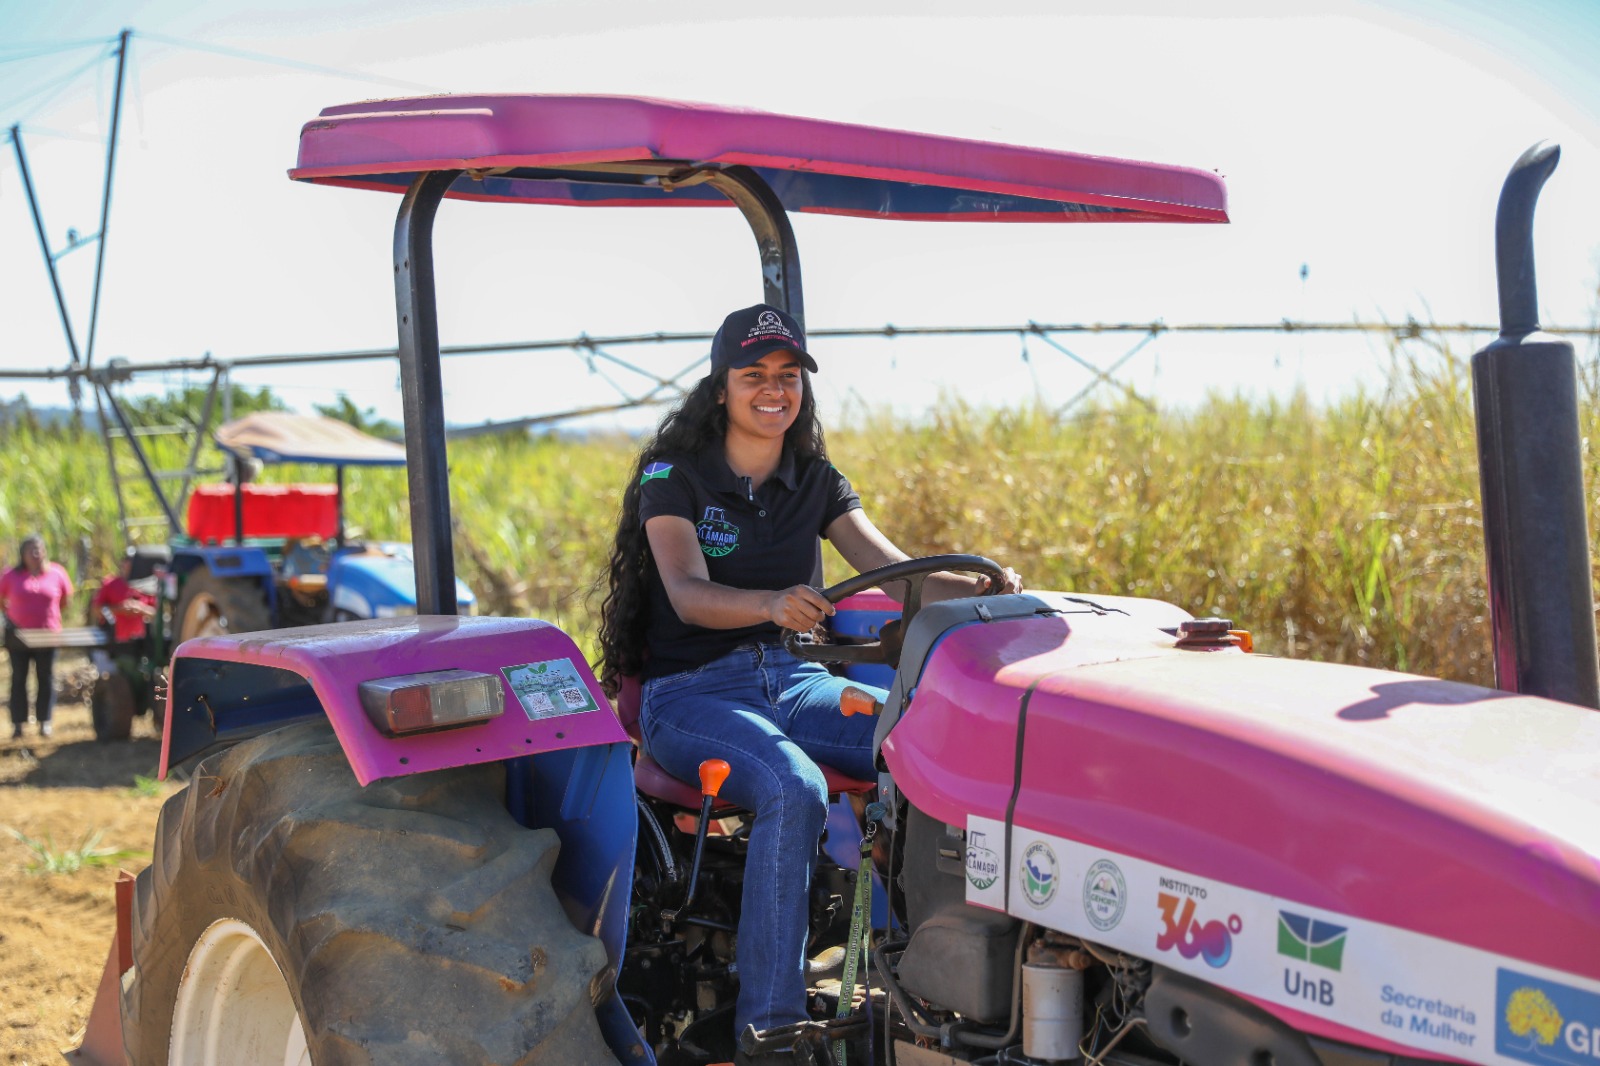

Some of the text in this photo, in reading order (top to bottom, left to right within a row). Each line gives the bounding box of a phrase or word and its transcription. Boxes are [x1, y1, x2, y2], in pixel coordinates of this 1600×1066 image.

[697, 529, 736, 544] LAMAGRI
[1159, 876, 1207, 899] INSTITUTO
[1284, 967, 1335, 1006] UnB
[1380, 984, 1476, 1025] Secretaria
[1380, 1009, 1476, 1047] da Mulher
